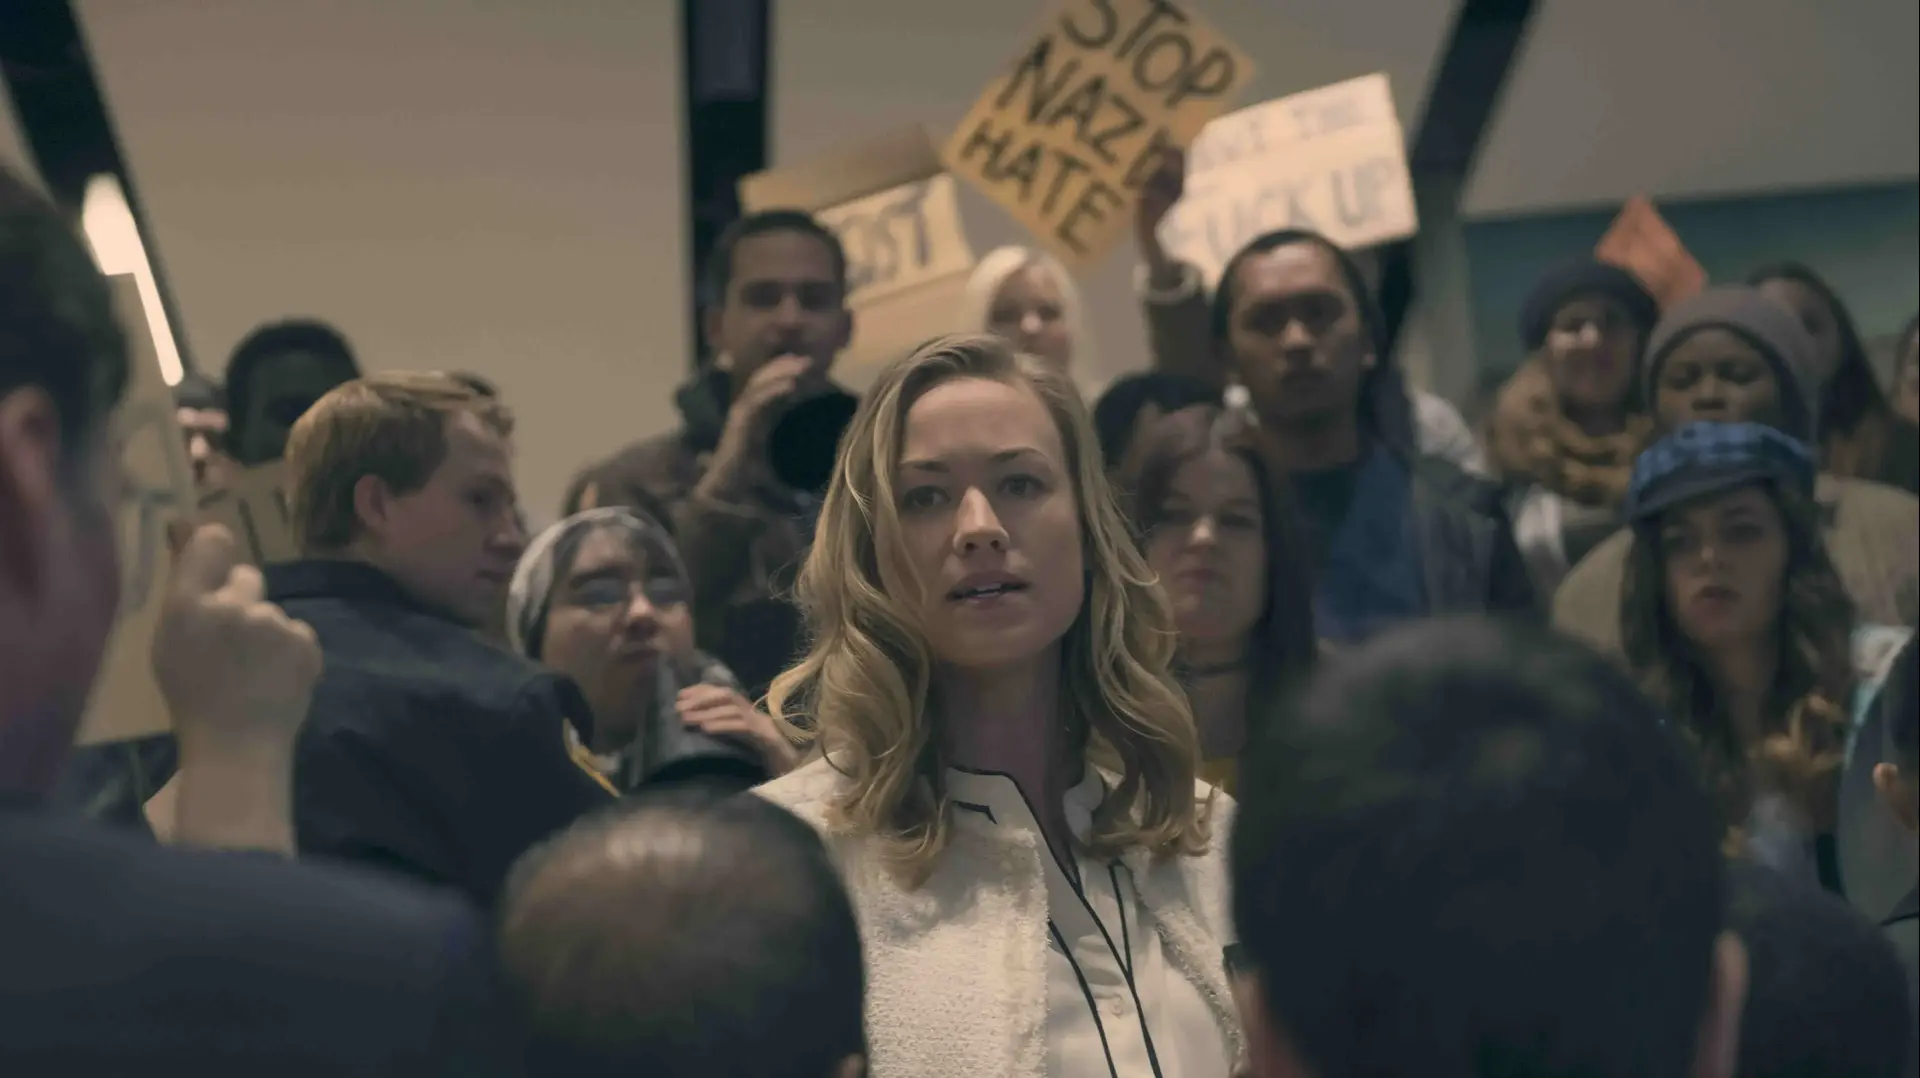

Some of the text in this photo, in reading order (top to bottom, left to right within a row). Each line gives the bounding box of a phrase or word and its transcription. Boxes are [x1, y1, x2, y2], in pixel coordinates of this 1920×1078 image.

[1059, 0, 1234, 108] STOP
[958, 118, 1125, 254] HATE
[1328, 154, 1398, 230] UP
